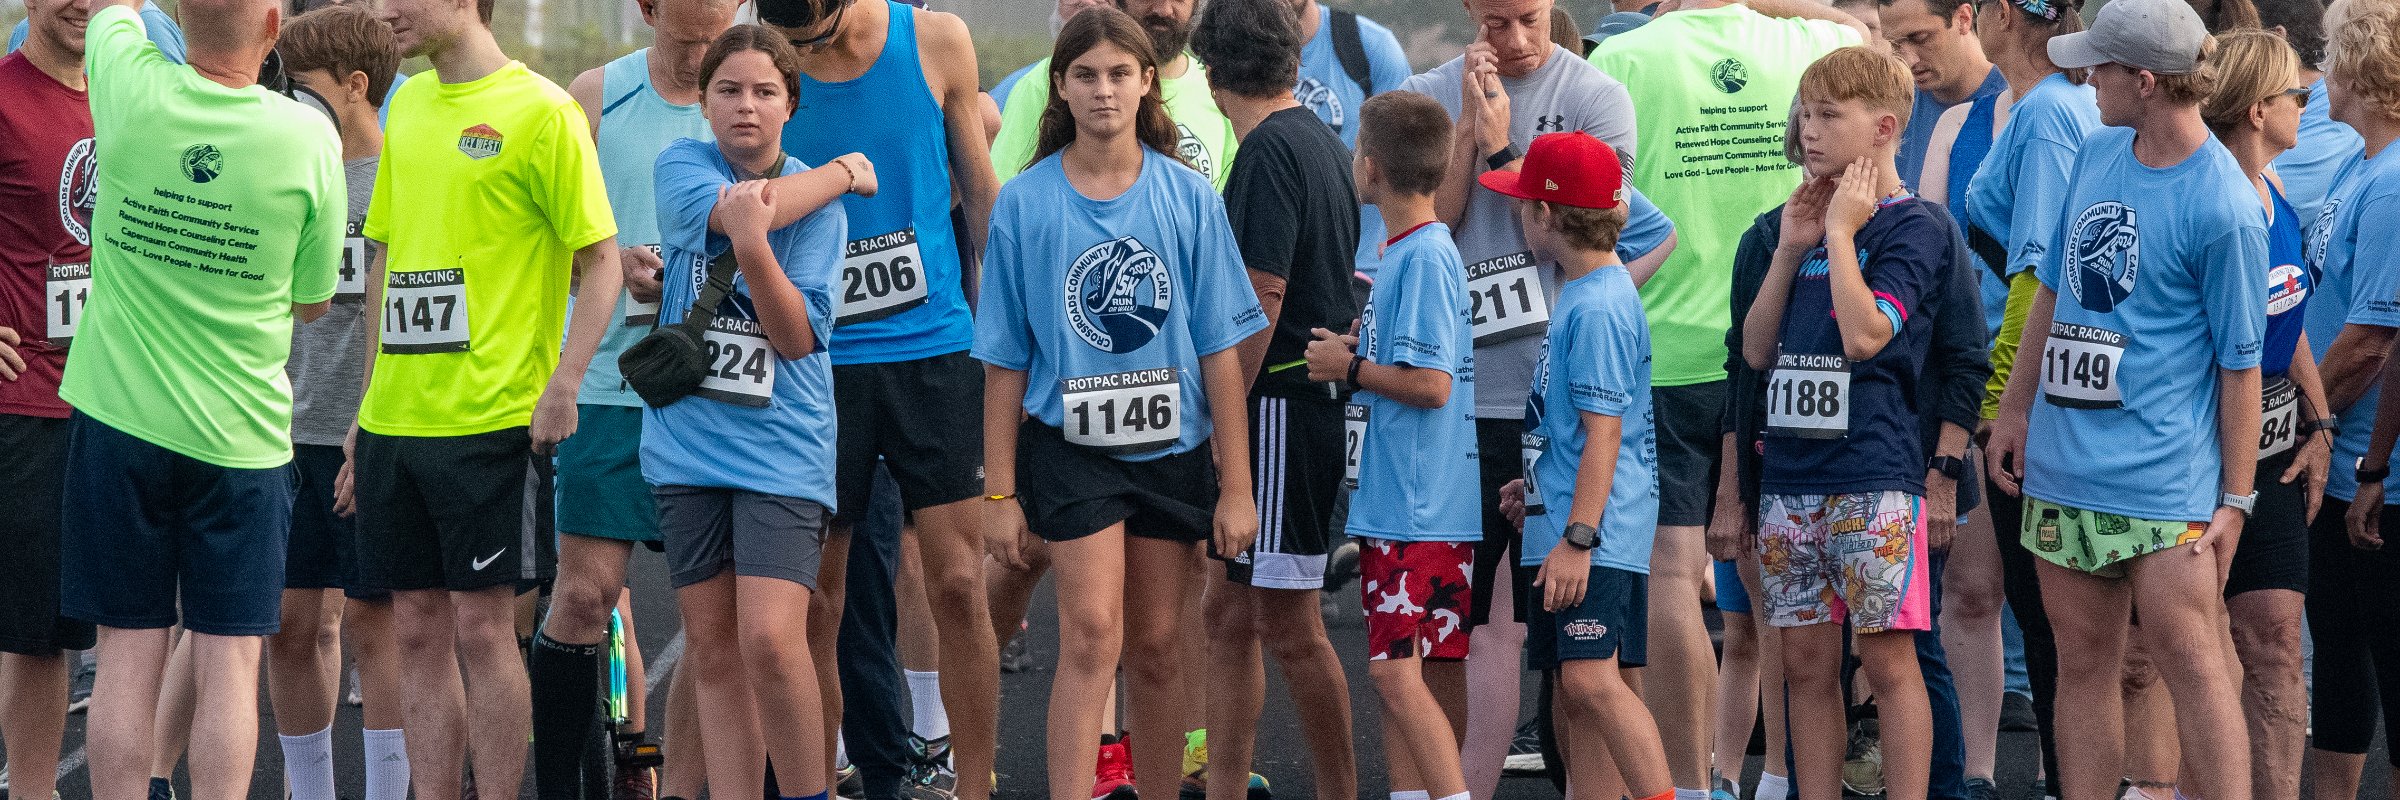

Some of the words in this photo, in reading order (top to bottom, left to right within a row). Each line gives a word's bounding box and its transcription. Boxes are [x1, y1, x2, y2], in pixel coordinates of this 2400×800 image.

[1700, 106, 1727, 115] helping
[1728, 106, 1737, 114] to
[1738, 104, 1768, 113] support
[1676, 126, 1700, 134] Active
[1700, 124, 1719, 132] Faith
[1720, 121, 1764, 131] Community
[1766, 120, 1787, 129] Servic
[1675, 139, 1709, 149] Renewed
[1710, 138, 1730, 146] Hope
[1732, 135, 1771, 145] Counseling
[63, 142, 88, 187] COMMUNITY
[1682, 153, 1723, 163] Capernaum
[1725, 149, 1767, 160] Community
[1768, 149, 1784, 157] Heal
[1664, 171, 1683, 179] Love
[1685, 169, 1700, 177] God
[1706, 168, 1723, 176] Love
[1725, 165, 1749, 174] People
[1756, 164, 1774, 172] Move
[1776, 163, 1786, 171] for
[153, 187, 185, 203] helping
[187, 195, 196, 204] to
[198, 199, 232, 212] support
[61, 187, 87, 241] CROSSROADS
[123, 196, 147, 211] Active
[147, 205, 169, 217] Faith
[171, 211, 222, 229] Community
[223, 222, 259, 235] Services
[119, 210, 154, 229] Renewed
[155, 222, 178, 235] Hope
[180, 228, 226, 246] Counseling
[227, 238, 257, 250] Center
[860, 231, 907, 252] RACING
[121, 227, 167, 247] Capernaum
[168, 241, 218, 260] Community
[218, 252, 248, 264] Health
[2075, 205, 2120, 236] COMMUNITY
[2125, 254, 2137, 283] CARE
[2318, 234, 2329, 262] CARE
[105, 233, 119, 247] Love
[120, 241, 137, 253] God
[143, 249, 163, 261] Love
[164, 254, 192, 268] People
[199, 263, 224, 275] Move
[225, 268, 239, 277] for
[240, 271, 265, 281] Good
[1068, 245, 1110, 292] COMMUNITY
[1129, 257, 1154, 276] 2024
[1479, 253, 1526, 275] RACING
[2097, 256, 2113, 270] RUN
[53, 264, 90, 278] ROTPAC
[408, 270, 455, 285] RACING
[694, 253, 704, 294] ROADS
[1115, 274, 1140, 298] 5K
[1156, 272, 1168, 301] CARE
[55, 287, 88, 325] 11
[1112, 298, 1133, 306] RUN
[726, 317, 763, 335] RACIN
[1067, 294, 1111, 348] CROSSROADS
[2078, 327, 2121, 344] RACING
[1800, 355, 1842, 369] RACING
[2046, 341, 2111, 391] 1149
[1068, 376, 1119, 391] ROTPAC
[1121, 369, 1170, 386] RACING
[1541, 363, 1549, 391] CARE
[1770, 378, 1840, 418] 1188
[2268, 387, 2297, 409] RACING
[1072, 393, 1172, 436] 1146
[1522, 433, 1544, 447] ACING
